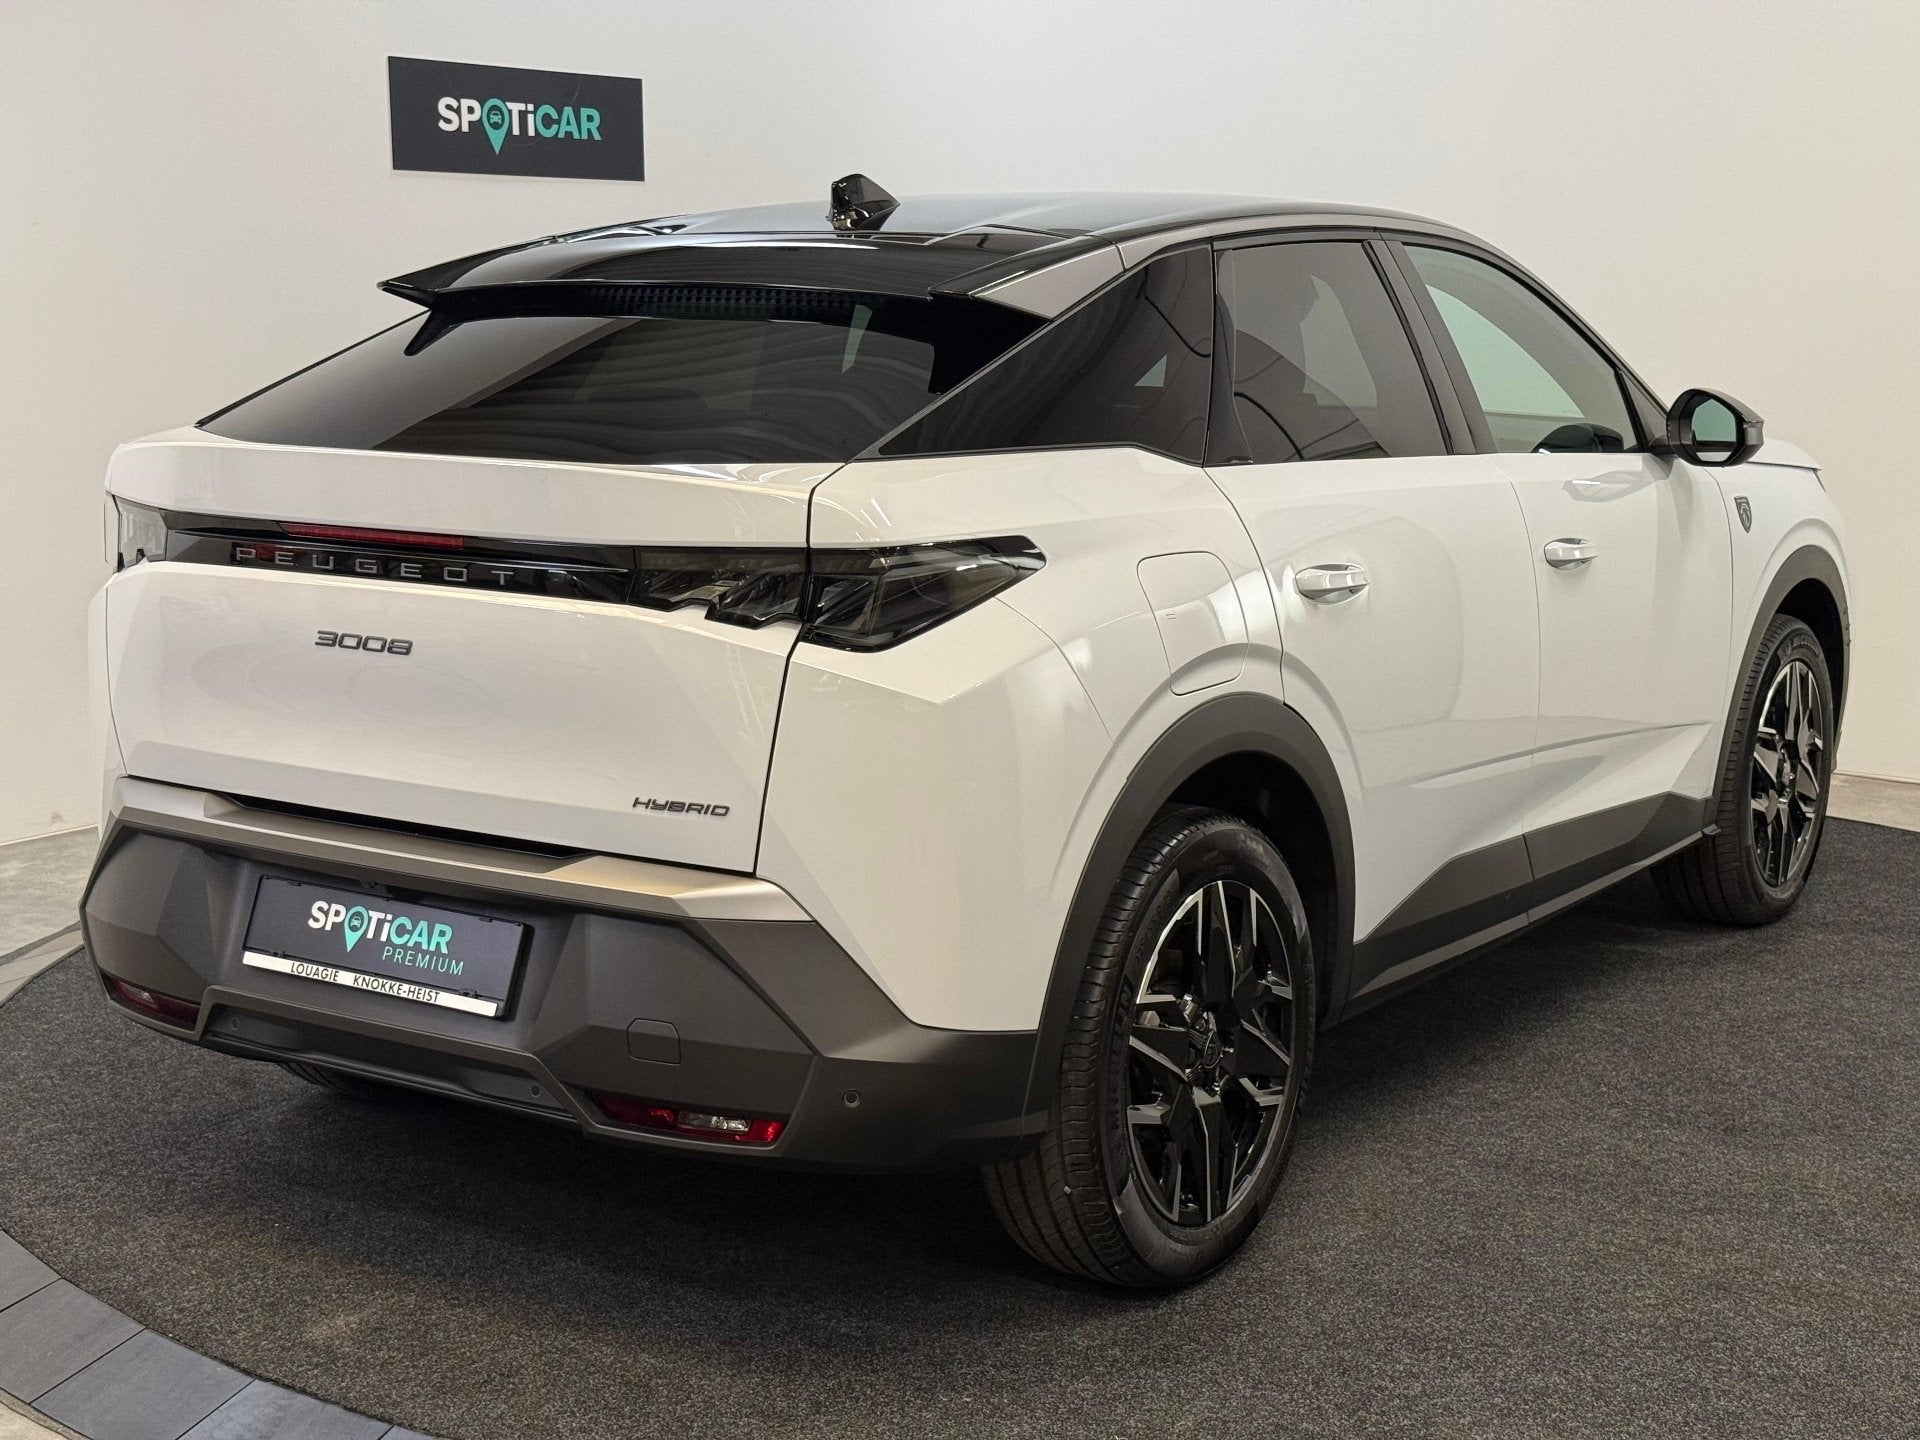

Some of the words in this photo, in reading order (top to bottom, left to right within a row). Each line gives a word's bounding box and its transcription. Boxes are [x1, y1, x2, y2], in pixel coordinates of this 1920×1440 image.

[236, 548, 514, 586] PEUGEOT
[315, 630, 413, 656] 3008
[632, 797, 730, 817] HYBRID
[382, 946, 464, 976] PREMIUM
[290, 961, 339, 983] LOUAGIE
[352, 974, 441, 1003] KNOKKE-HEIST
